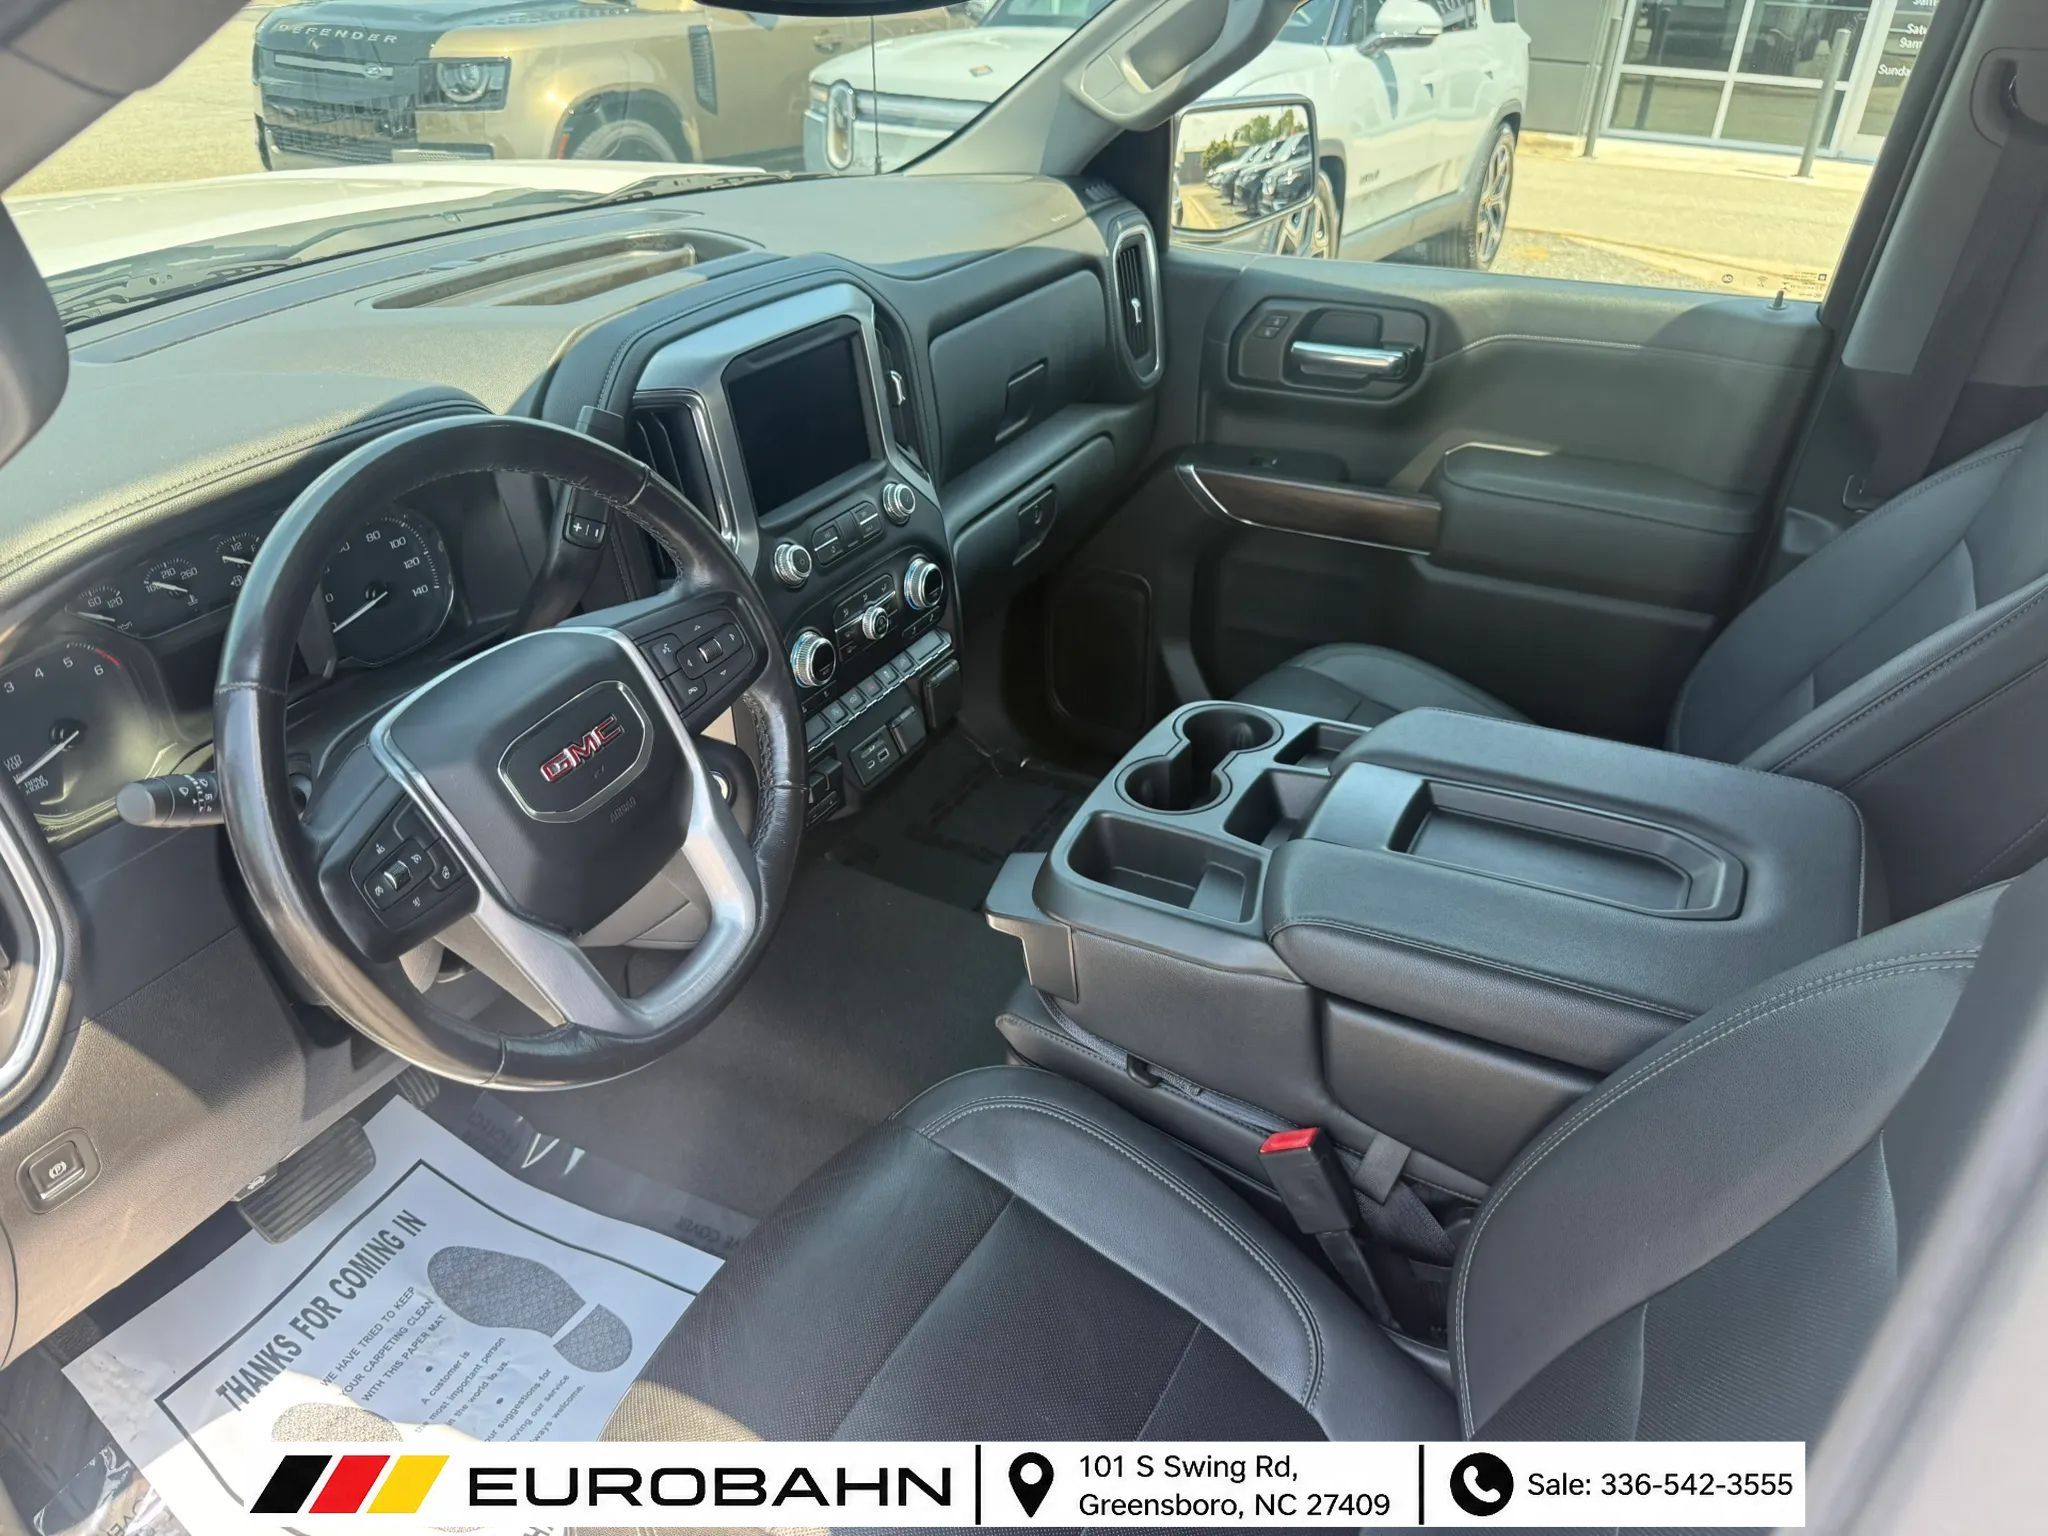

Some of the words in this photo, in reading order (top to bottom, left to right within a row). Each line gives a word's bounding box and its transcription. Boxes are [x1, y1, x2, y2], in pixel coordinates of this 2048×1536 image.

[279, 24, 398, 43] DEFENDER
[366, 530, 381, 542] 80
[389, 536, 407, 549] 100
[404, 557, 420, 569] 120
[160, 567, 176, 580] 210
[179, 567, 198, 580] 260
[412, 584, 429, 597] 140
[87, 597, 101, 608] 60
[106, 597, 123, 608] 120
[62, 657, 74, 668] 5
[93, 664, 104, 676] 6
[34, 667, 44, 678] 4
[4, 681, 15, 693] 3
[540, 713, 625, 783] GMC
[216, 1334, 302, 1411] THANKS
[289, 1296, 342, 1341] FOR
[328, 1229, 405, 1300] COMING
[392, 1209, 427, 1237] IN
[320, 1371, 338, 1386] WE
[335, 1347, 361, 1372] HAVE
[358, 1323, 384, 1348] TRIED
[381, 1310, 396, 1322] TO
[393, 1286, 414, 1310] KEEP
[339, 1373, 365, 1397] YOUR
[363, 1326, 408, 1372] CARPETING
[407, 1298, 434, 1326] CLEAN
[361, 1380, 385, 1402] WITH
[383, 1360, 404, 1379] THIS
[402, 1331, 430, 1360] PAPER
[427, 1314, 447, 1332] MAT
[429, 1360, 462, 1396] customer
[459, 1351, 470, 1359] is
[429, 1401, 450, 1420] most
[447, 1364, 483, 1400] important
[481, 1337, 506, 1364] person
[454, 1404, 468, 1417] the
[468, 1381, 489, 1403] world
[487, 1373, 498, 1381] to
[497, 1361, 510, 1372] us.
[497, 1382, 541, 1428] suggestions
[538, 1368, 552, 1381] for
[552, 1385, 585, 1418] welcome.
[506, 1418, 533, 1442] oving
[531, 1403, 544, 1417] our
[544, 1375, 569, 1402] service
